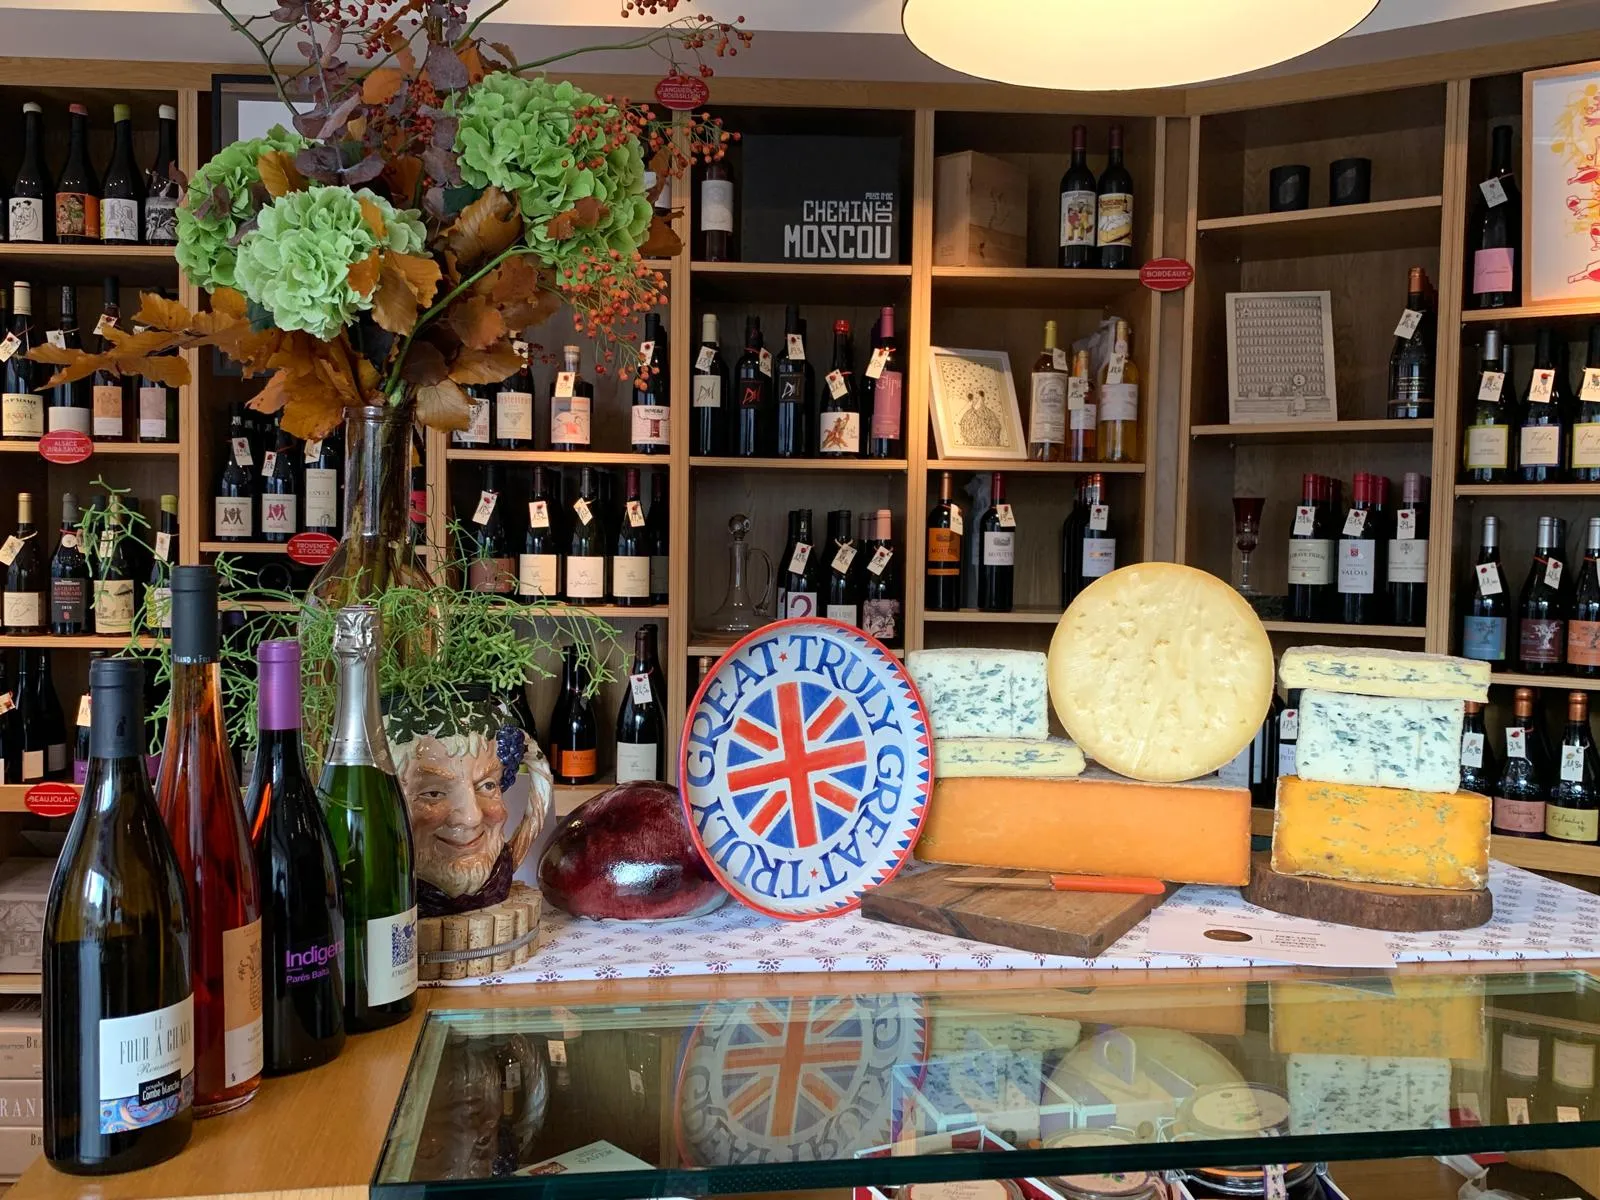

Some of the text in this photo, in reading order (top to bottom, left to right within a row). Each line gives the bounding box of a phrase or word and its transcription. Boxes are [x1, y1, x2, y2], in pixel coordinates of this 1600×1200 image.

[803, 200, 873, 222] CHEMIN
[875, 201, 893, 223] DE
[784, 224, 892, 259] MOSCOU
[1146, 270, 1187, 278] BORDEAUX
[687, 637, 810, 899] TRULY GREAT
[788, 635, 905, 893] TRULY GREAT
[154, 1016, 163, 1031] LE
[26, 1035, 42, 1049] BR
[120, 1036, 149, 1065] FOUR
[142, 1080, 181, 1102] Combe blanche
[0, 1097, 43, 1117] RAN
